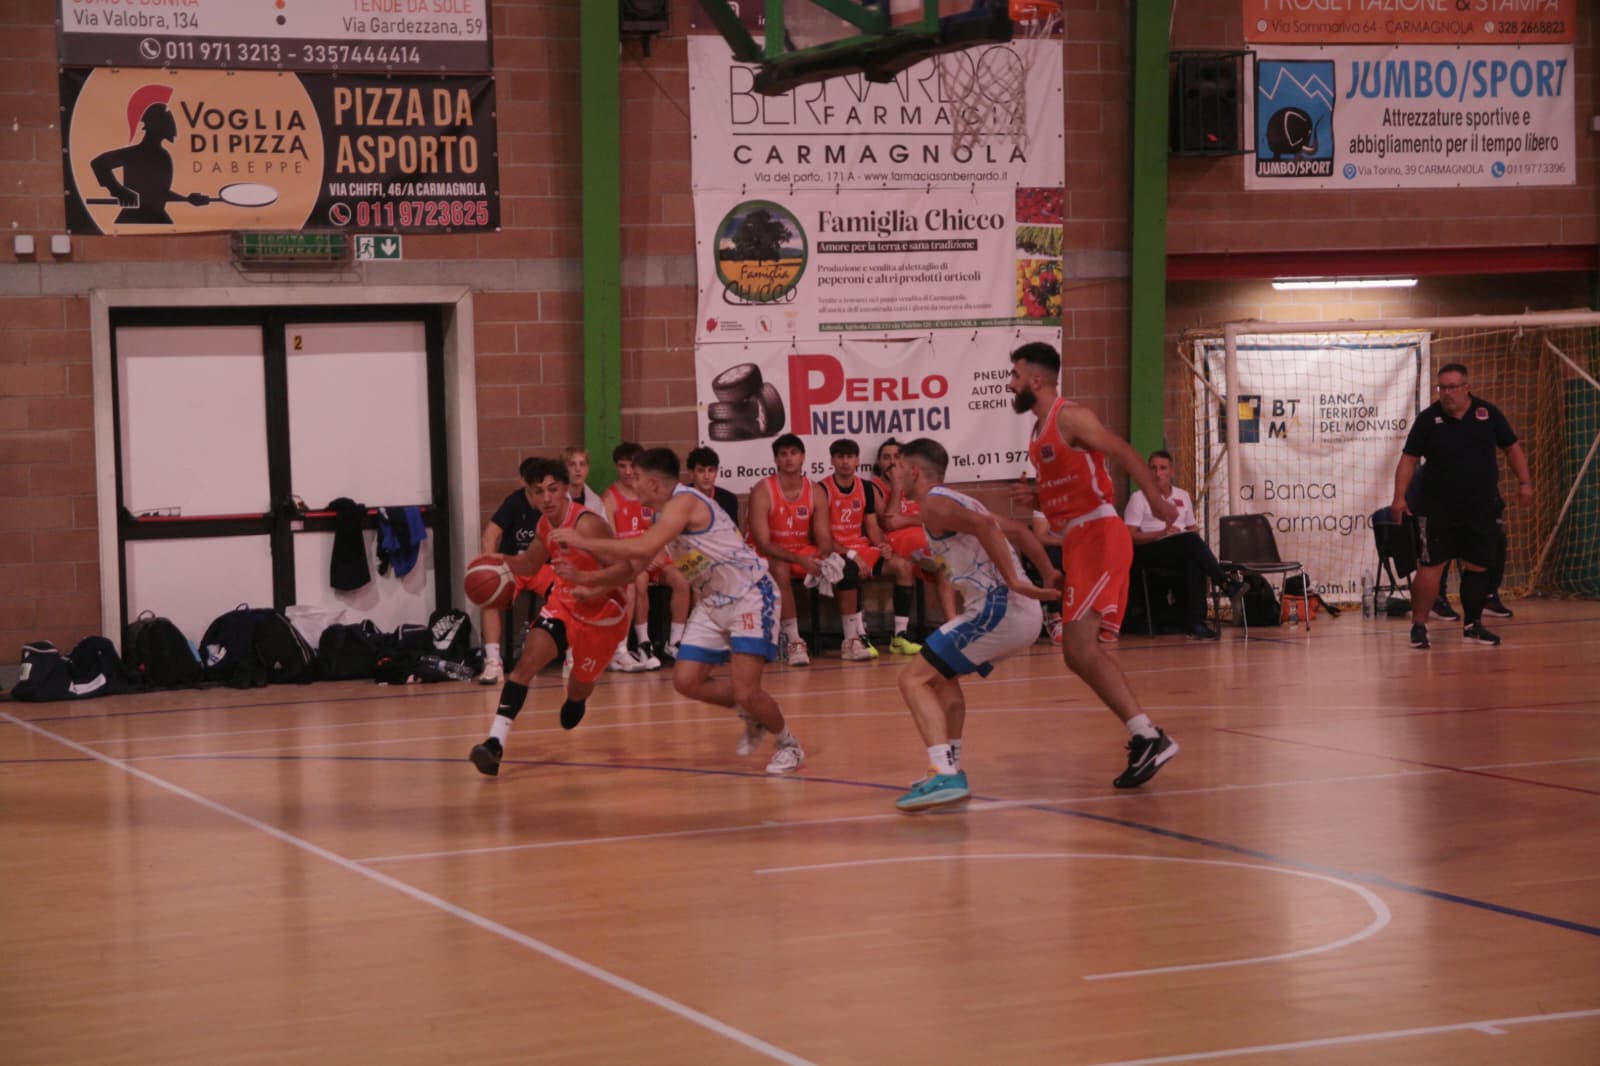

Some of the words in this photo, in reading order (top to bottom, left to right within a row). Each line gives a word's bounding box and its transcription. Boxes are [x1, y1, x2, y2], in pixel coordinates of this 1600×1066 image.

[74, 10, 98, 26] Via
[103, 10, 169, 30] Valobra,
[173, 12, 199, 28] 134
[342, 16, 365, 33] Via
[370, 17, 462, 36] Gardezzana,
[466, 18, 483, 34] 59
[1271, 20, 1290, 32] Via
[1294, 20, 1360, 32] Sommariva
[1362, 21, 1376, 33] 64
[1385, 20, 1474, 34] CARMAGNOLA
[1498, 21, 1518, 34] 328
[166, 42, 194, 60] 011
[200, 42, 231, 61] 971
[238, 44, 281, 62] 3213
[303, 45, 420, 64] 3357444414
[1346, 59, 1568, 103] JUMBO/SPORT
[334, 87, 425, 126] PIZZA
[433, 88, 473, 127] DA
[180, 101, 306, 130] VOGLIA
[1382, 108, 1463, 127] Attrezzature
[1466, 107, 1520, 130] sportive
[1522, 110, 1531, 126] e
[190, 134, 218, 153] DI
[229, 134, 310, 160] PIZZA
[1349, 134, 1442, 159] abbigliamento
[1446, 137, 1468, 158] per
[1470, 133, 1479, 152] il
[1482, 134, 1522, 156] tempo
[1524, 132, 1559, 152] libero
[336, 135, 478, 174] ASPORTO
[734, 144, 1026, 164] CARMAGNOLA
[1258, 160, 1331, 175] JUMBO/SPORT
[1358, 165, 1372, 175] Via
[1404, 165, 1416, 175] 39
[1418, 164, 1484, 175] CARMAGNOLA
[754, 172, 770, 182] Via
[774, 172, 790, 182] del
[328, 183, 347, 196] VIA
[349, 183, 386, 198] CHIFFI,
[388, 183, 414, 196] 46/A
[416, 182, 486, 196] CARMAGNOLA
[356, 201, 394, 226] 011
[400, 201, 489, 226] 9723625
[818, 210, 918, 238] Famiglia
[925, 208, 1005, 232] Chicco
[819, 242, 850, 252] Amore
[851, 243, 866, 254] per
[868, 242, 876, 251] la
[878, 242, 901, 251] terra
[931, 240, 974, 250] tradizione
[740, 264, 789, 283] Famiglia
[818, 264, 860, 272] Produzione
[818, 274, 864, 287] peperoni
[866, 276, 872, 284] e
[875, 273, 898, 284] altri
[899, 272, 942, 286] prodotti
[944, 270, 981, 282] orticoli
[294, 336, 302, 350] 2
[974, 370, 1013, 382] PNEUM
[788, 354, 949, 435] PERLO
[972, 384, 1002, 396] AUTO
[968, 399, 1007, 410] CERCHI
[1320, 393, 1364, 406] BANCA
[1272, 399, 1300, 417] BT
[1320, 406, 1378, 419] TERRITORI
[1320, 420, 1342, 433] DEL
[1344, 418, 1407, 432] MONVISO
[952, 454, 975, 467] Tel.
[978, 452, 1000, 466] 011
[720, 466, 732, 478] ia
[737, 466, 776, 478] Racco
[811, 462, 824, 474] 55
[1240, 484, 1254, 500] a
[1264, 480, 1336, 500] Banca
[631, 516, 638, 530] 8
[786, 516, 793, 529] 4
[840, 508, 852, 522] 22
[1264, 512, 1375, 536] armagno
[580, 658, 596, 672] 21
